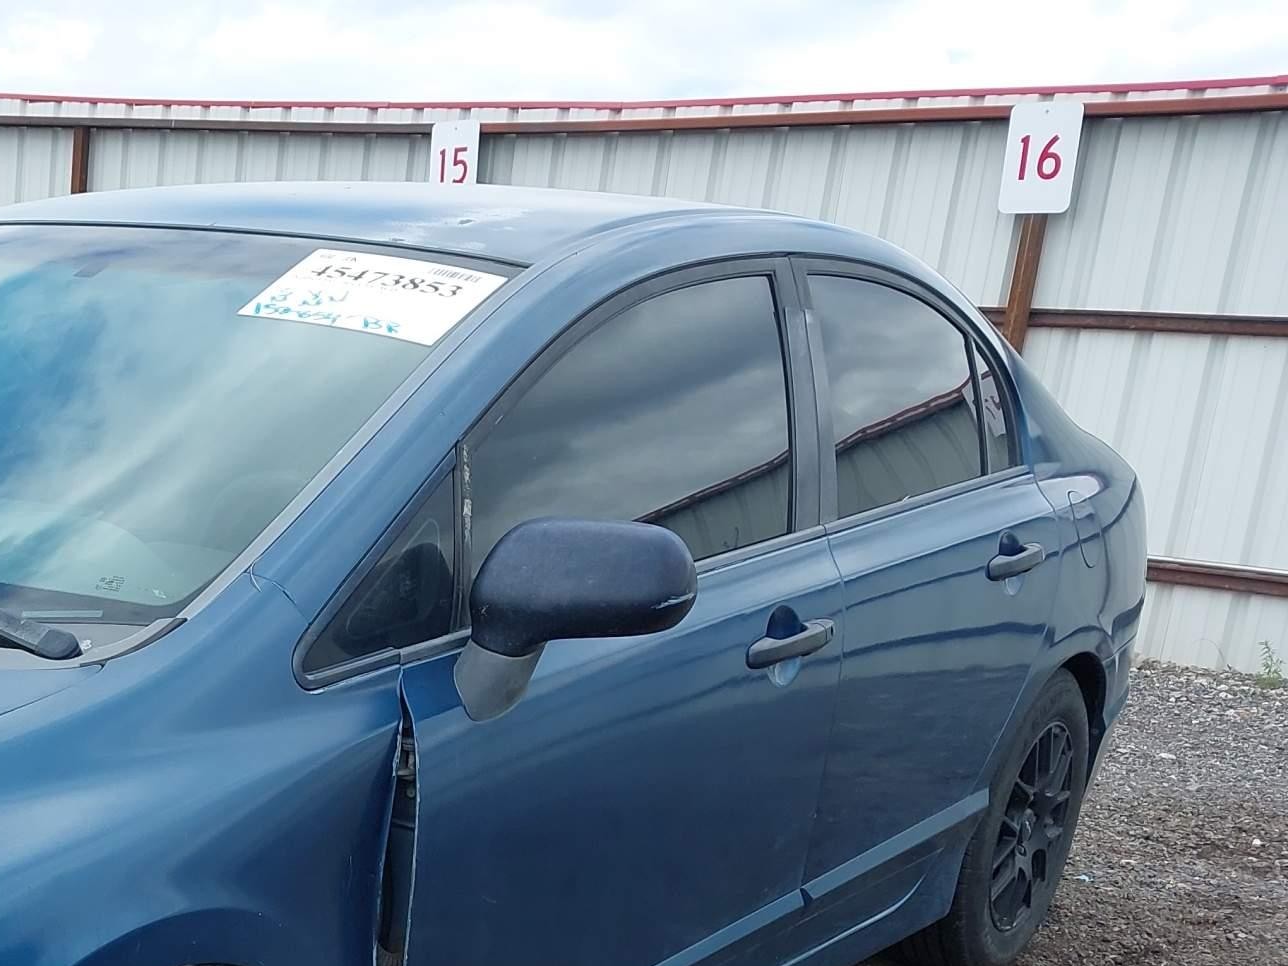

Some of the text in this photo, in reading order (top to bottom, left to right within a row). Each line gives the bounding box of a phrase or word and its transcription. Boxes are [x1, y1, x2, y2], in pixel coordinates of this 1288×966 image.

[440, 146, 468, 184] 15
[1017, 134, 1062, 181] 16
[312, 264, 464, 298] 45473853
